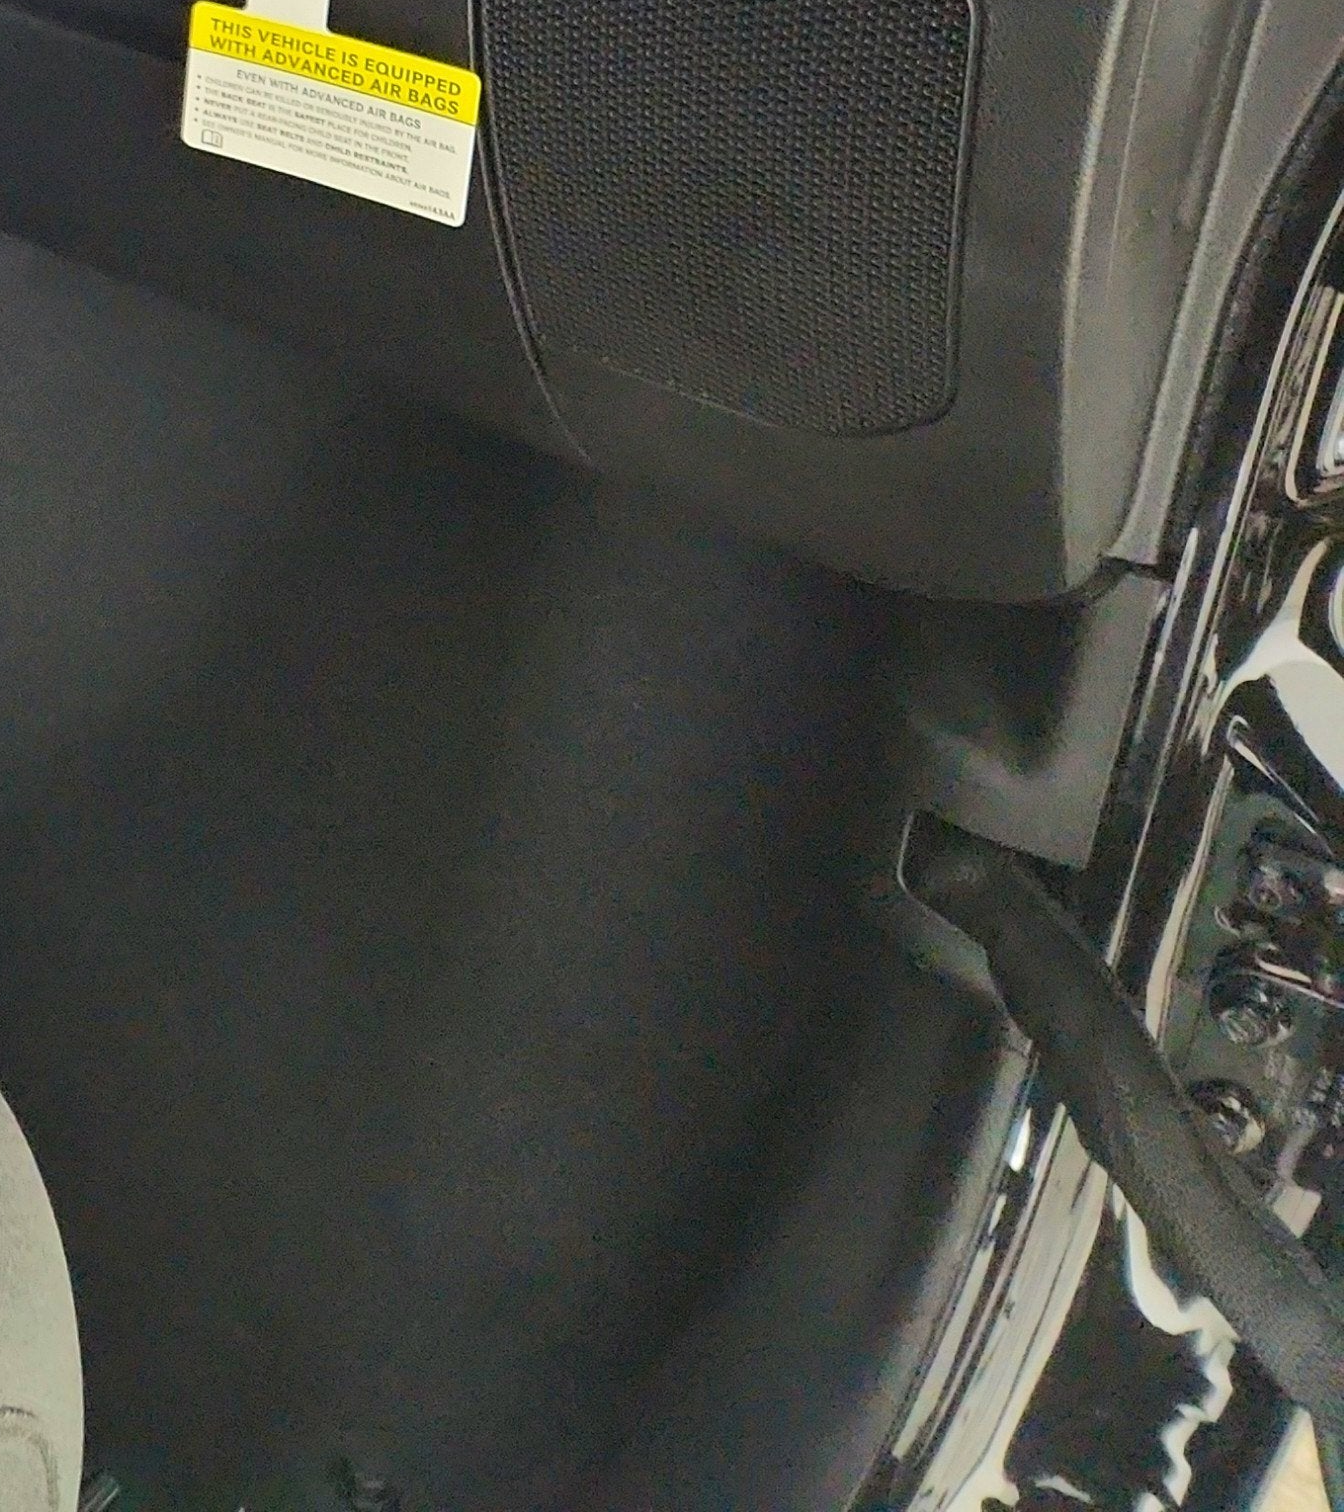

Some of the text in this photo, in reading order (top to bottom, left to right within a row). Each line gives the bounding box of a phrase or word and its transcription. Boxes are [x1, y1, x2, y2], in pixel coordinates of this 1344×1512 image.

[209, 34, 459, 114] WITH ADVANCED AIR BAGS
[210, 17, 461, 96] THIS VEHICLE IS EQUIPPED
[236, 70, 422, 129] EVEN WITH ADVANCED AIR BAGS
